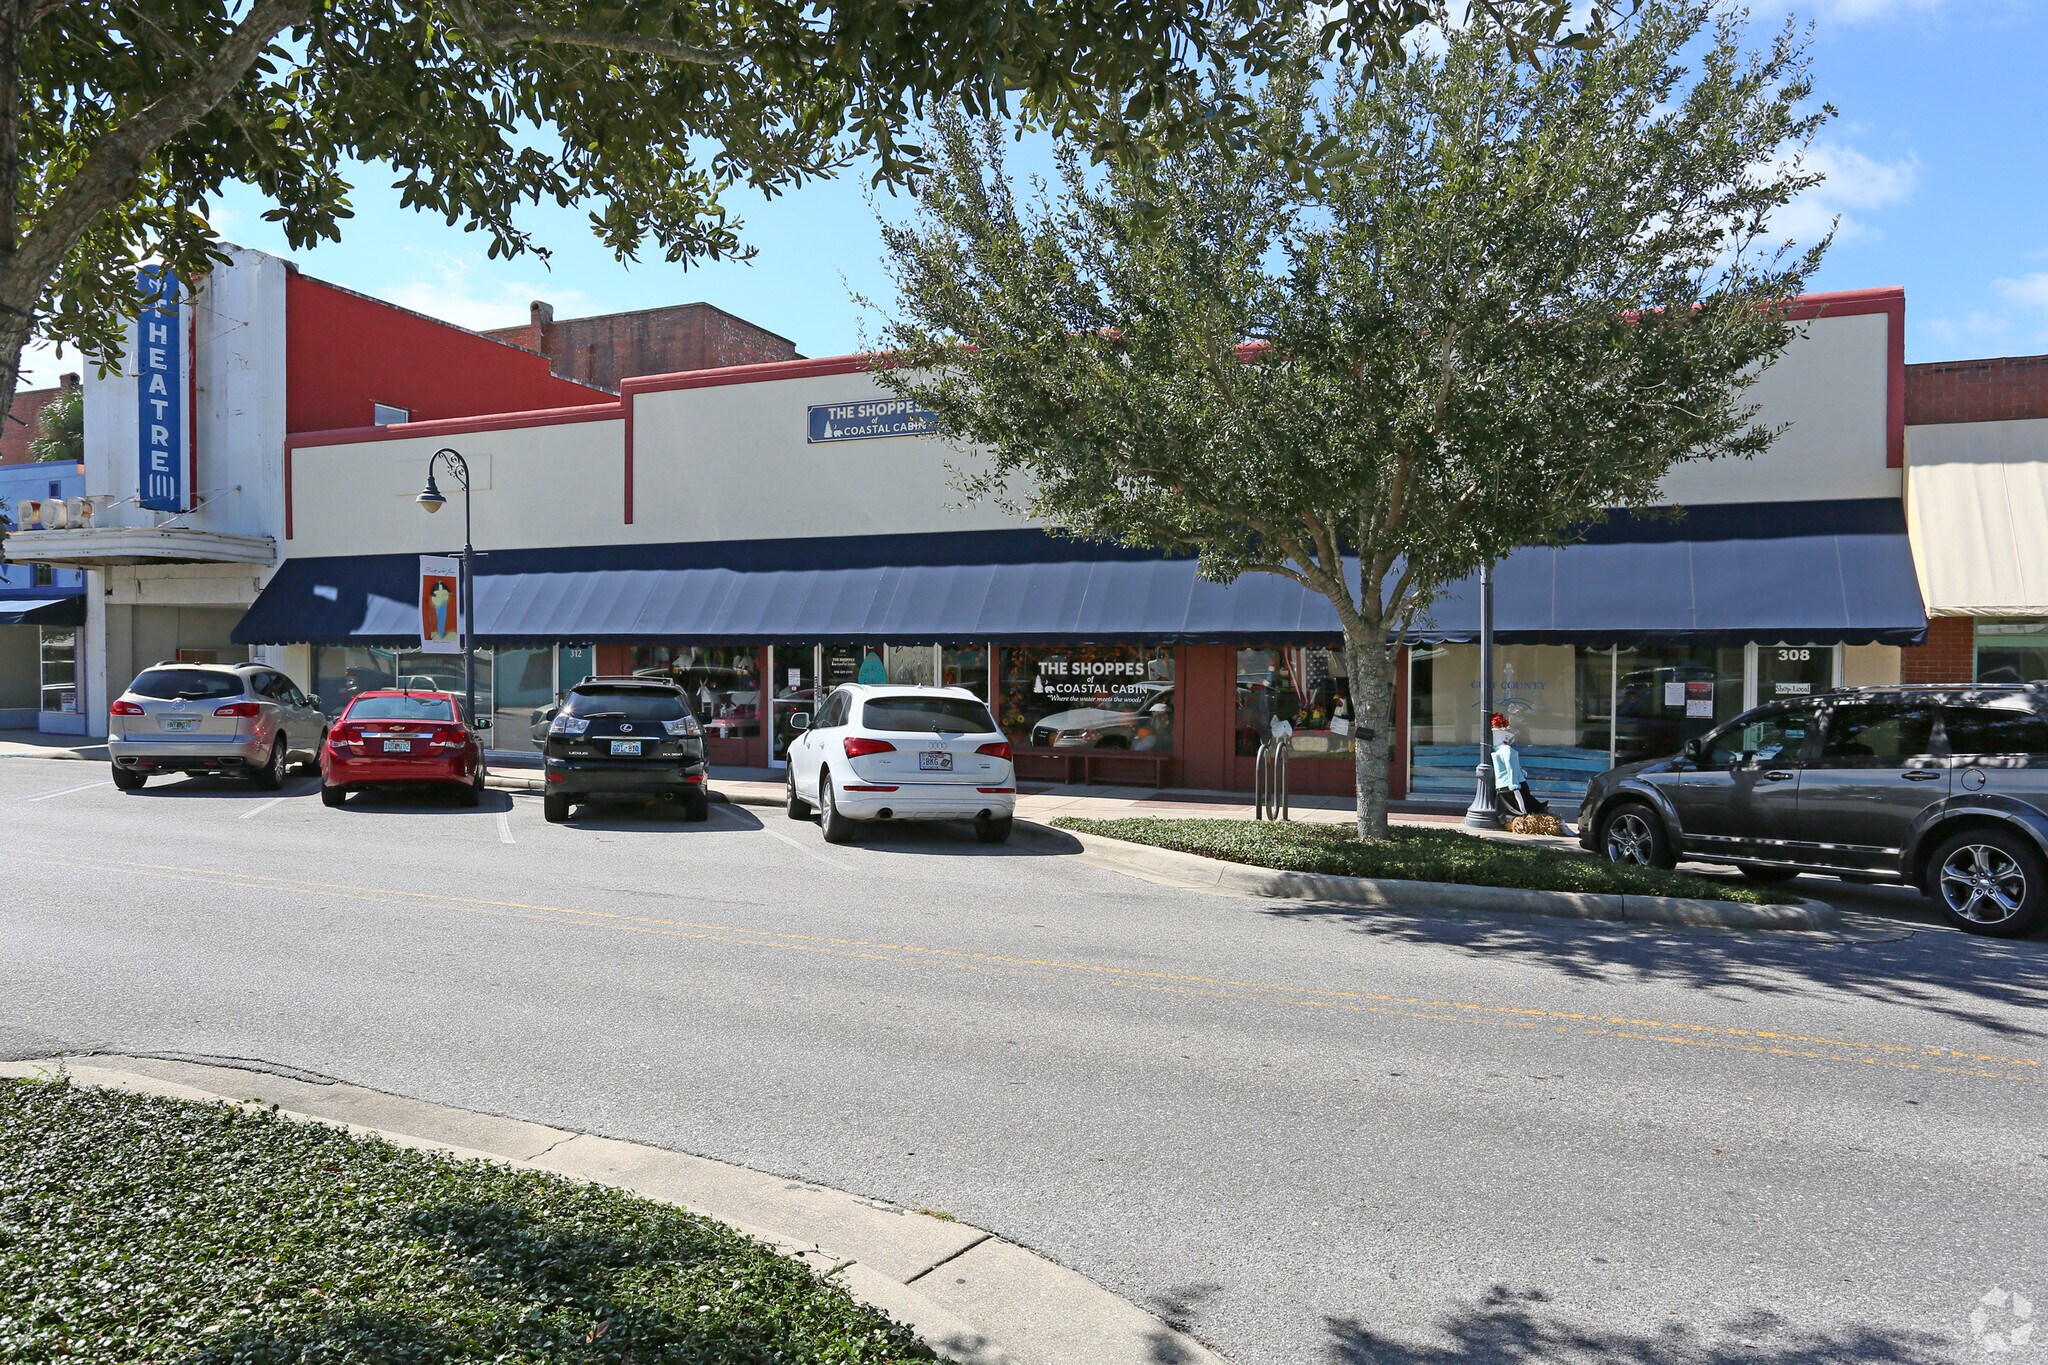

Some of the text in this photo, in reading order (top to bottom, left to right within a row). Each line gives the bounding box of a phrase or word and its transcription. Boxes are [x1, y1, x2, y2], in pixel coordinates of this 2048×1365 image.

[828, 401, 923, 420] THE SHOPPES
[871, 416, 879, 424] of
[844, 424, 890, 436] COASTAL
[570, 649, 582, 658] 312
[1778, 649, 1810, 661] 308
[1038, 662, 1144, 675] THE SHOPPES
[1086, 676, 1095, 684] of
[1056, 683, 1148, 694] COASTAL CABIN
[1501, 681, 1546, 690] COUNTY
[1776, 684, 1810, 694] Shop Local
[1114, 695, 1122, 703] the
